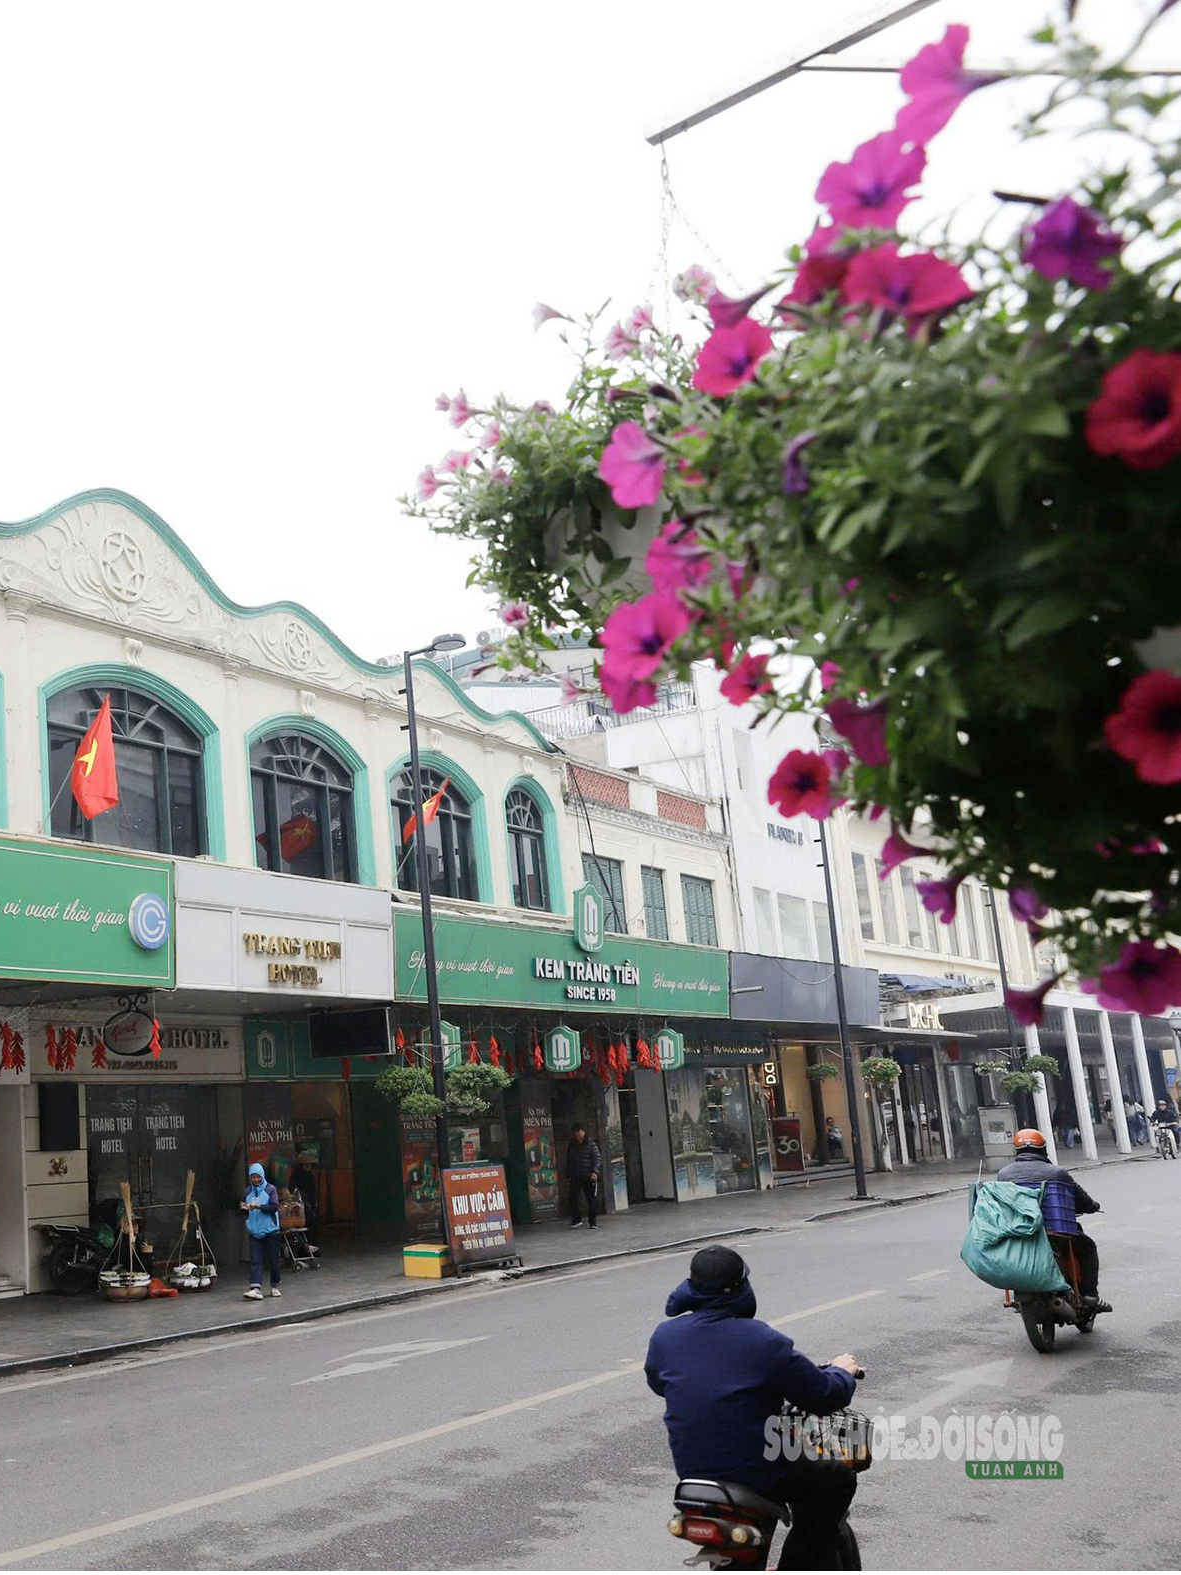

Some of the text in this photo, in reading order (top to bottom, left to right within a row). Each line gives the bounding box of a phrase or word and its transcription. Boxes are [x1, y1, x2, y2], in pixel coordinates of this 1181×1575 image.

[90, 911, 125, 933] gian
[535, 957, 639, 985] KEM TRÀNG TIỀN
[567, 985, 616, 1002] SINCE 1958
[172, 1029, 230, 1048] HOTEL
[90, 1118, 114, 1132] TRANG
[145, 1116, 168, 1130] TRANG
[101, 1139, 124, 1153] HOTEL
[155, 1136, 177, 1150] HOTEL
[778, 1136, 800, 1155] 30
[451, 1184, 506, 1217] KHU VỰC CẤM
